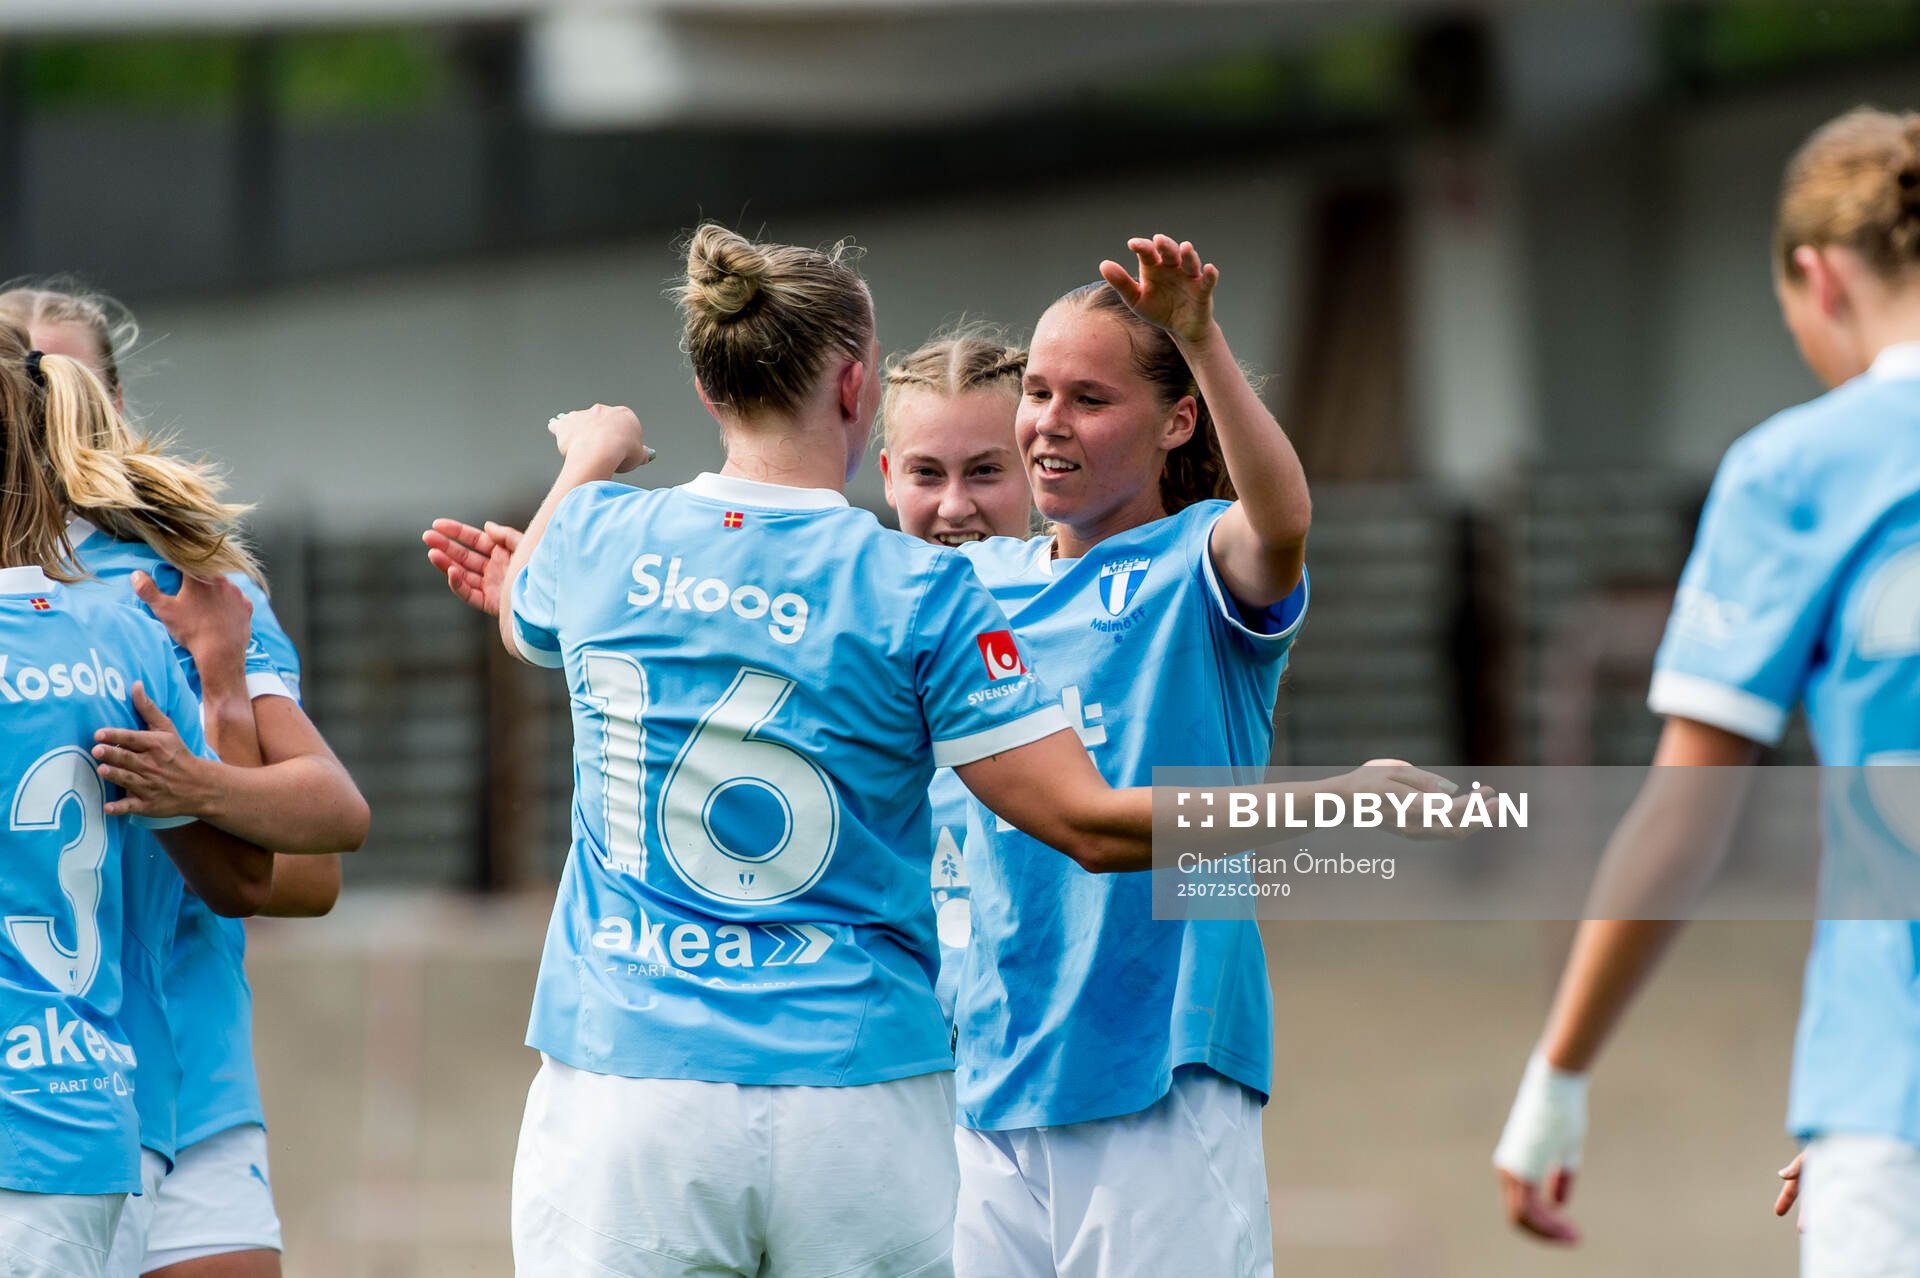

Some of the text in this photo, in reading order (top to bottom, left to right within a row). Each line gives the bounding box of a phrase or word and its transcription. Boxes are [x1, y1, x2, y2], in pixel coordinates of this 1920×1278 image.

[627, 553, 809, 645] Skoog
[1090, 606, 1146, 633] Malmö FF
[582, 649, 840, 906] 16
[4, 745, 108, 997] 3
[591, 906, 754, 968] akea
[627, 963, 667, 977] PART
[49, 1077, 110, 1094] PART OF
